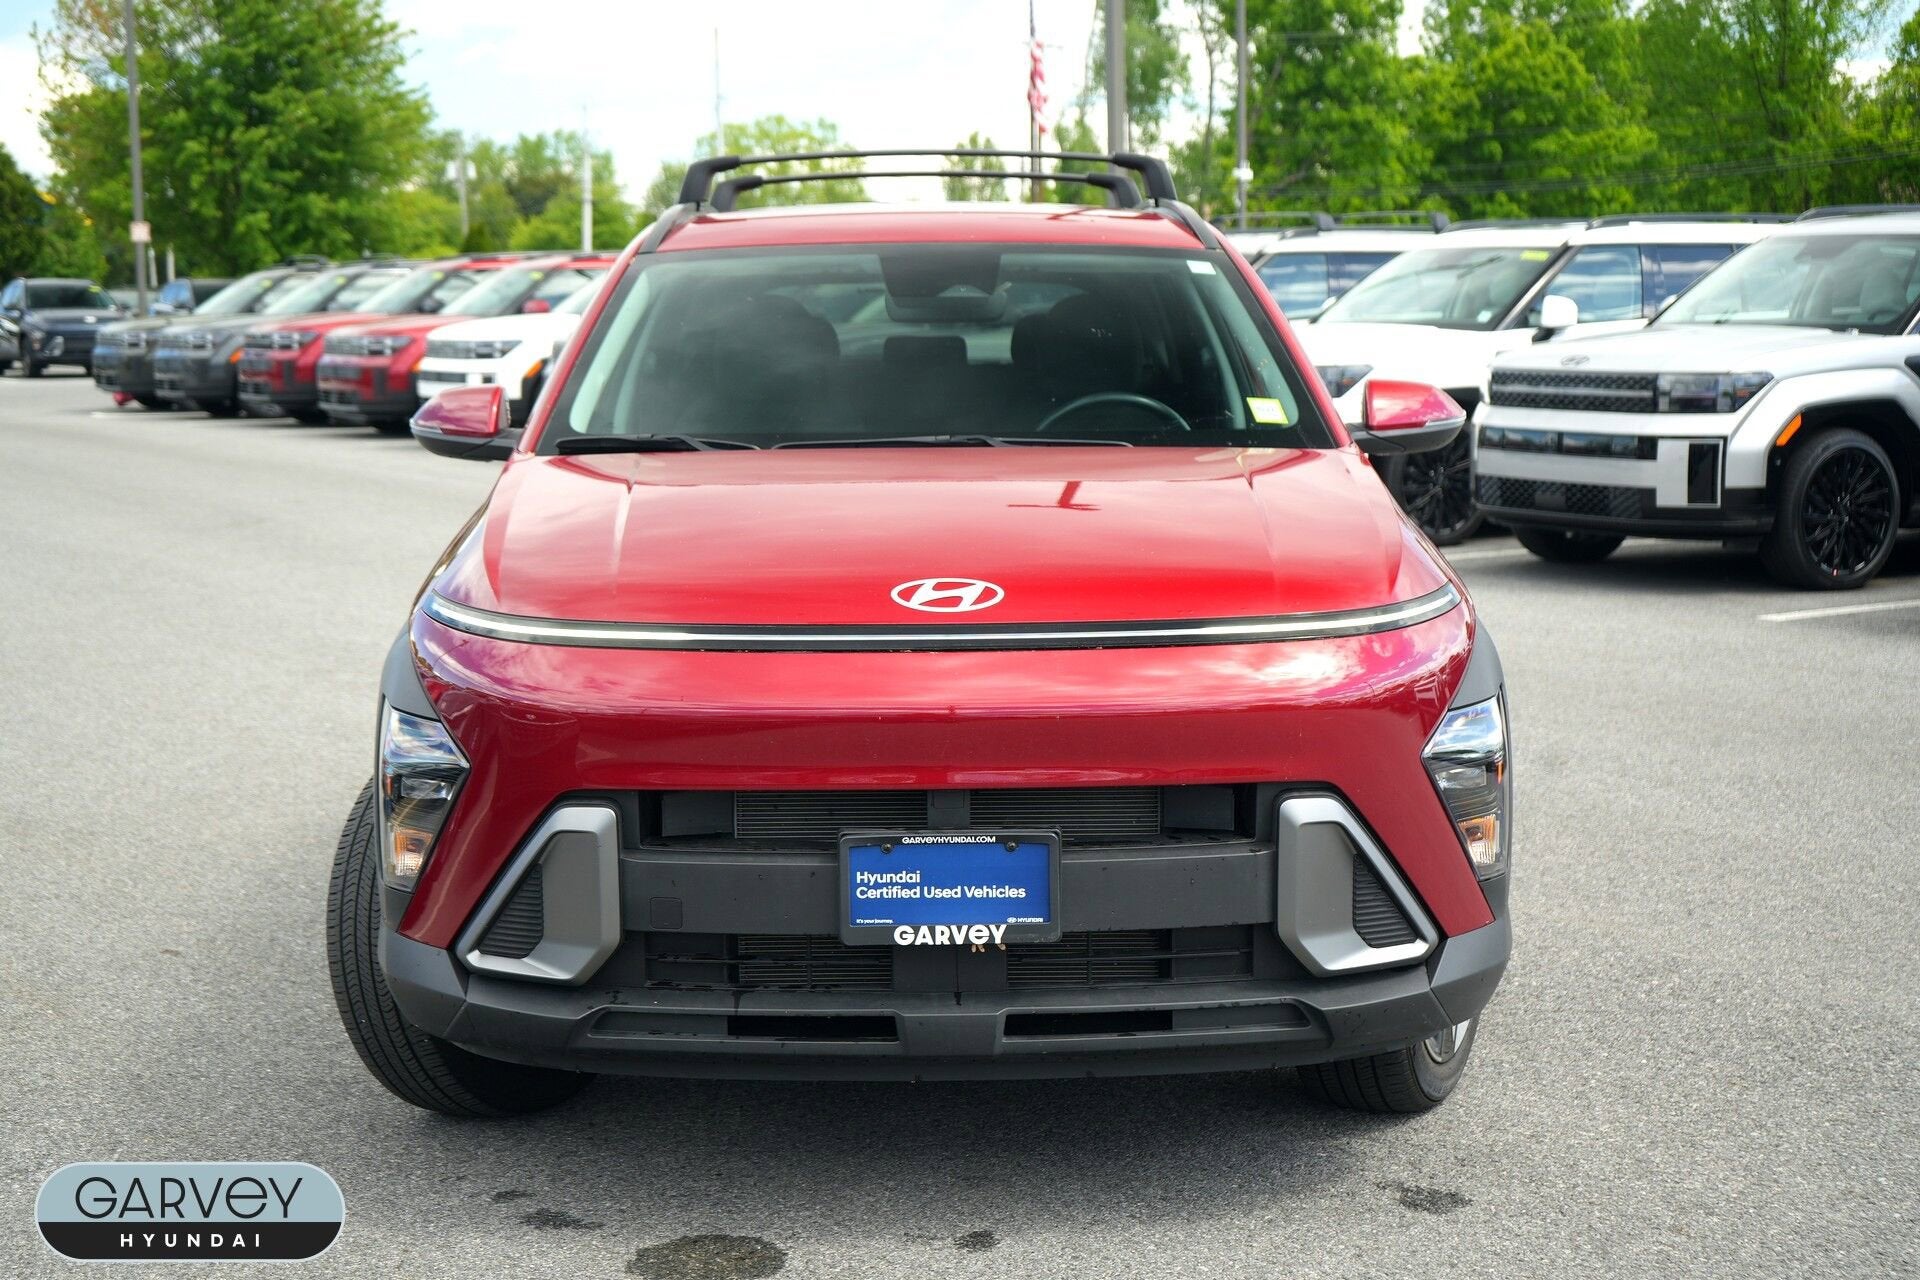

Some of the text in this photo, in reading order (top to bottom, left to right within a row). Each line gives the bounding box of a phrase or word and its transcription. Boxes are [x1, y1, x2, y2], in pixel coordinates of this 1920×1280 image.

[856, 870, 921, 886] Hyundai
[856, 885, 1027, 899] Certified Used Vehicles
